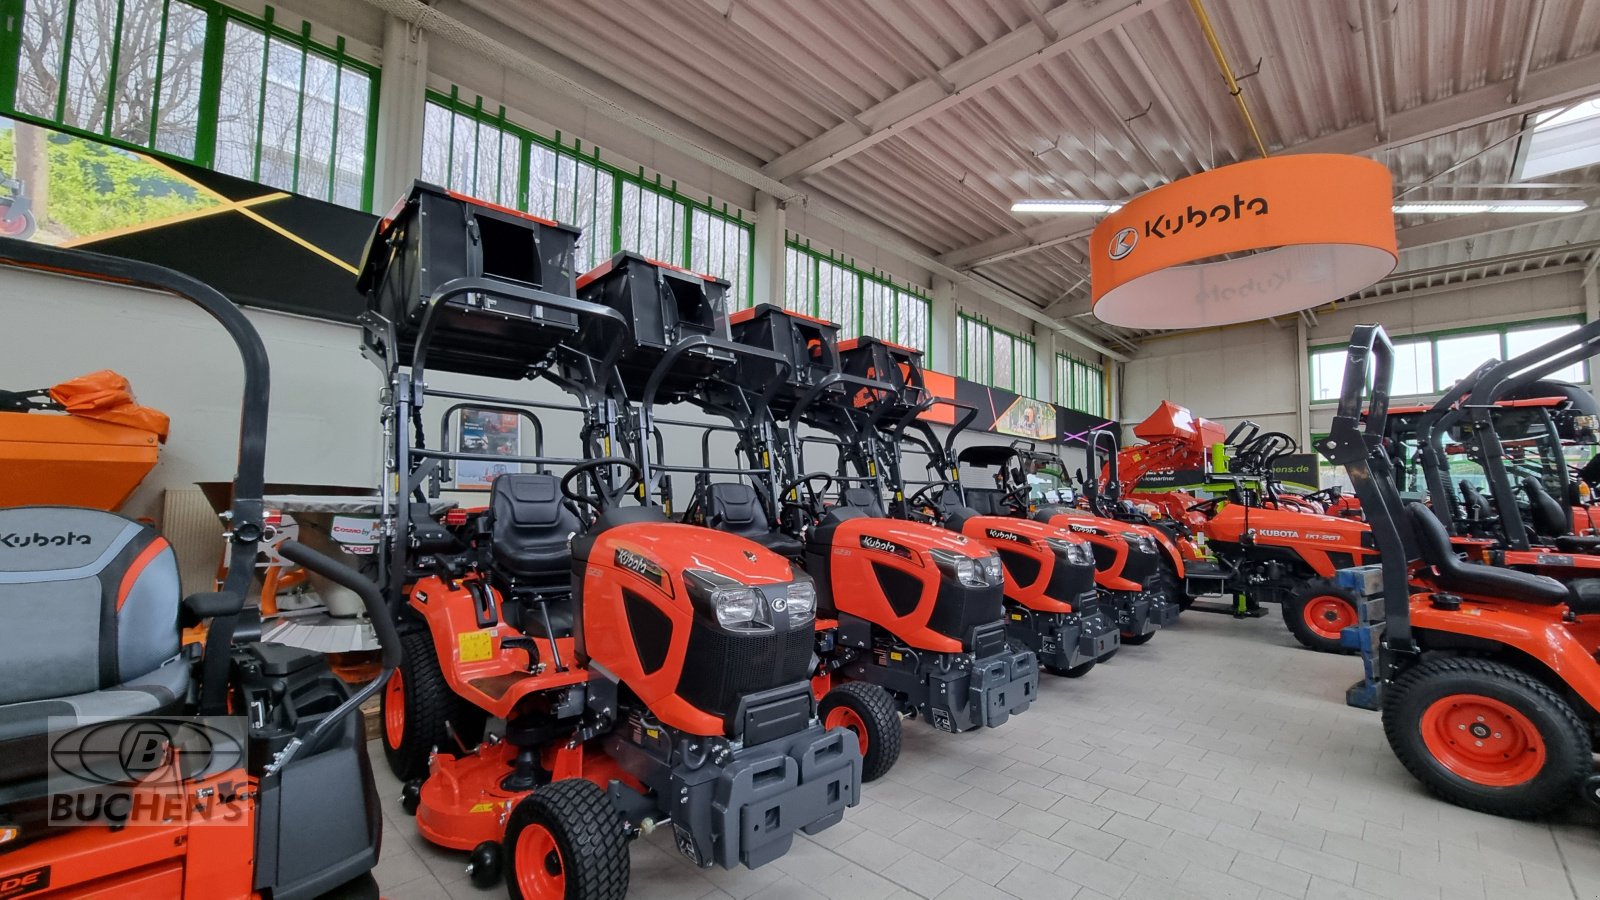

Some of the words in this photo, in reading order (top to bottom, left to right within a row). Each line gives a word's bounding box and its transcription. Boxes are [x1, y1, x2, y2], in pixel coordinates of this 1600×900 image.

[1145, 195, 1268, 239] Kubota
[0, 531, 92, 548] Kubota
[989, 529, 1017, 541] Kubota
[1259, 529, 1299, 538] KUBOTA
[863, 536, 896, 552] Kubota
[617, 549, 647, 574] Kubota
